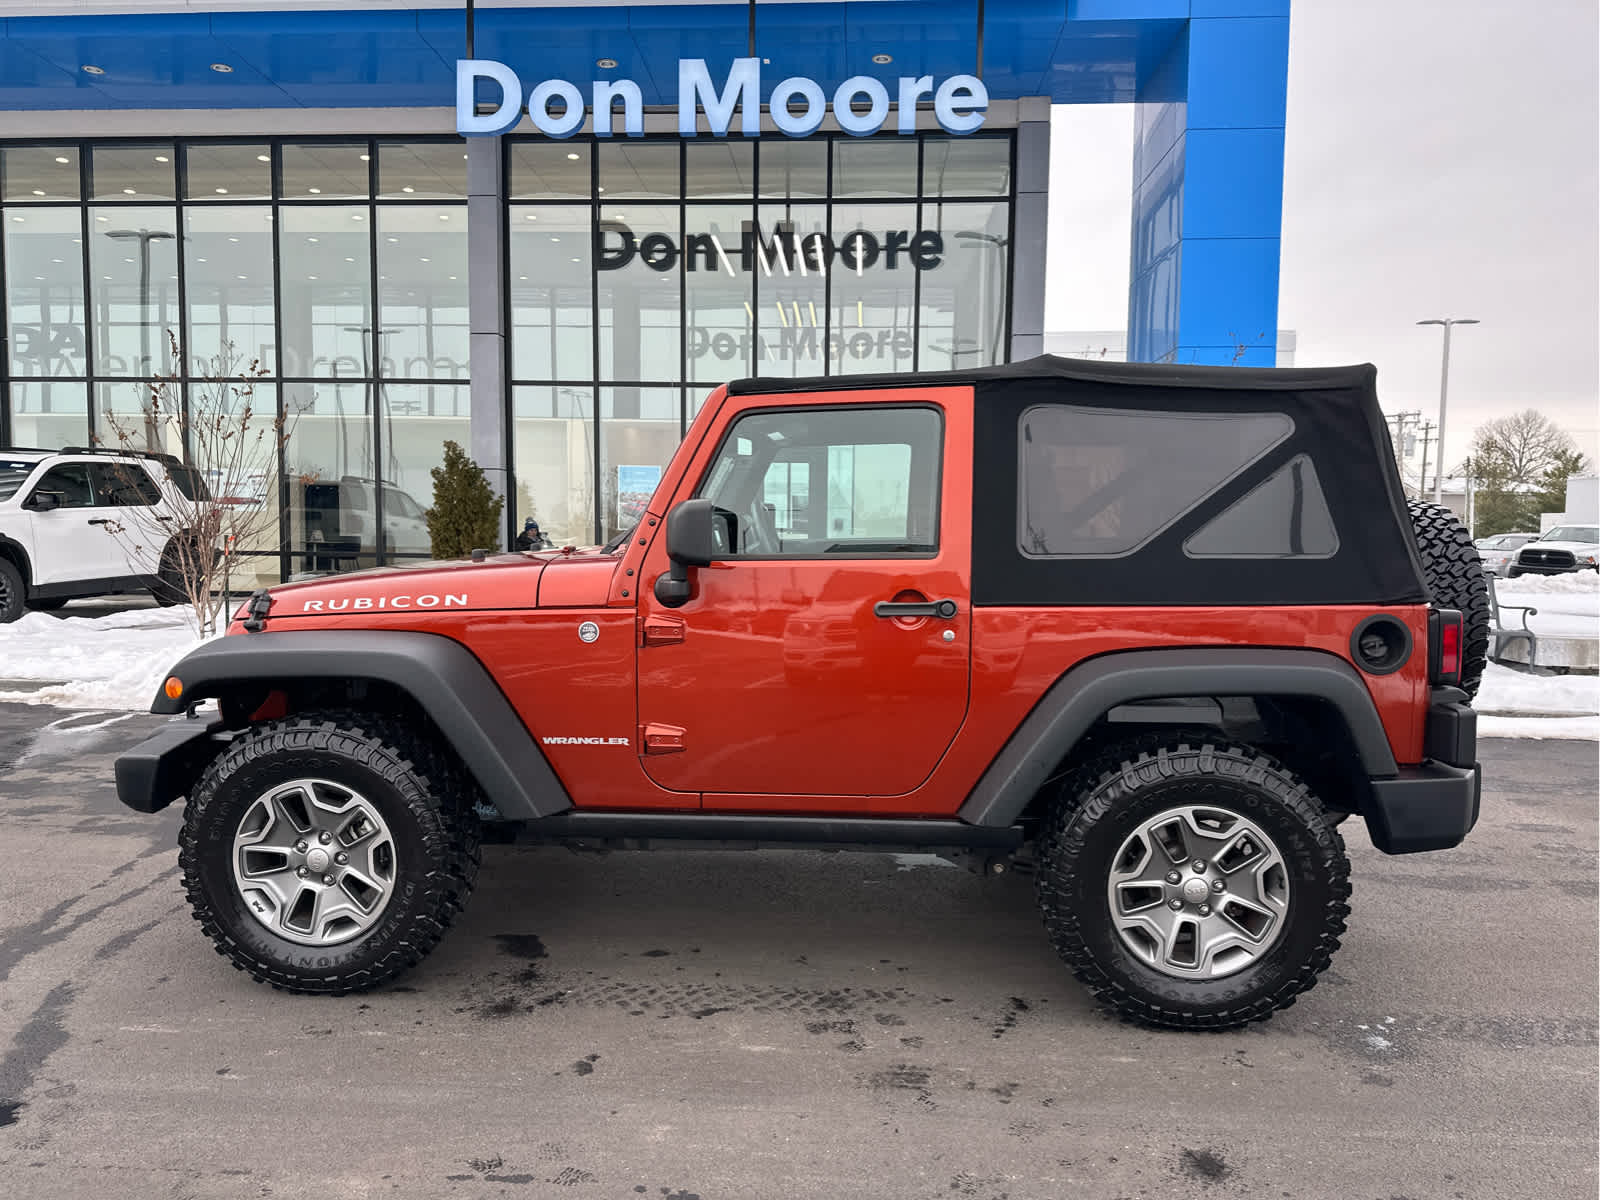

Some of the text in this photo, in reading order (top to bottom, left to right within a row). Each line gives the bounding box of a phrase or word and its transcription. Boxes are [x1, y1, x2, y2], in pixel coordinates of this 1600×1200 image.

[456, 57, 989, 139] Don Moore
[597, 220, 944, 272] Don Moore
[688, 327, 765, 361] Don
[303, 594, 468, 612] RUBICON
[542, 736, 630, 746] WRANGLER
